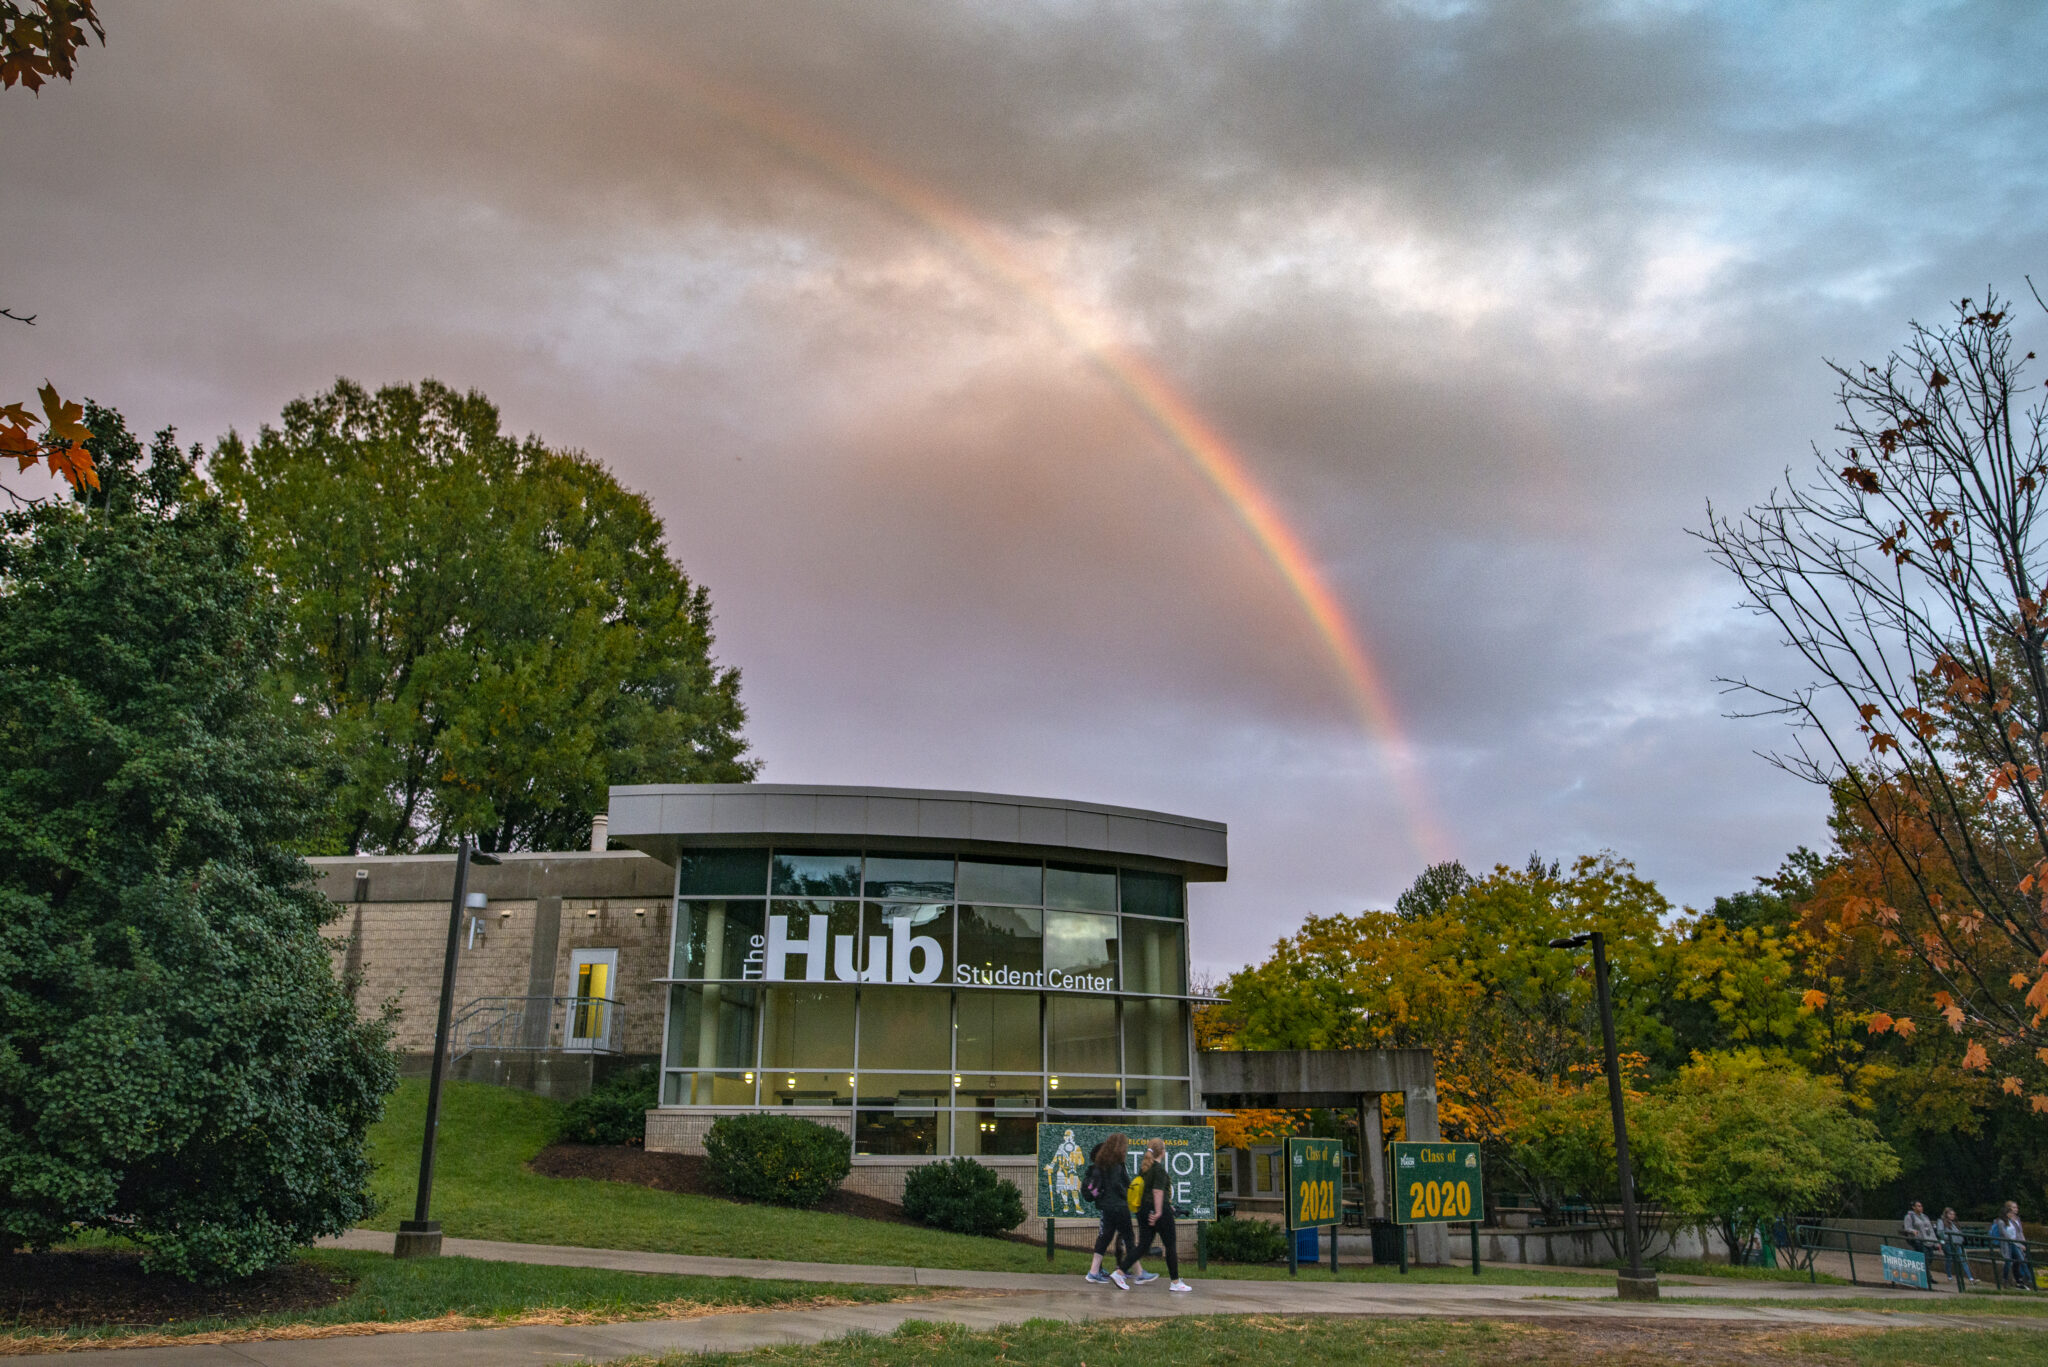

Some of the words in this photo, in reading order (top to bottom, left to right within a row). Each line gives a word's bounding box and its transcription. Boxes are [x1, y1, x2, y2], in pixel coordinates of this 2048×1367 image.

[743, 934, 764, 980] The
[766, 914, 944, 984] Hub
[956, 963, 1044, 987] Student
[1048, 968, 1114, 992] Center
[1305, 1145, 1320, 1161] Class
[1322, 1145, 1329, 1161] of
[1420, 1148, 1444, 1163] Class
[1447, 1149, 1456, 1163] of
[1299, 1180, 1335, 1222] 2021
[1410, 1180, 1471, 1219] 2020
